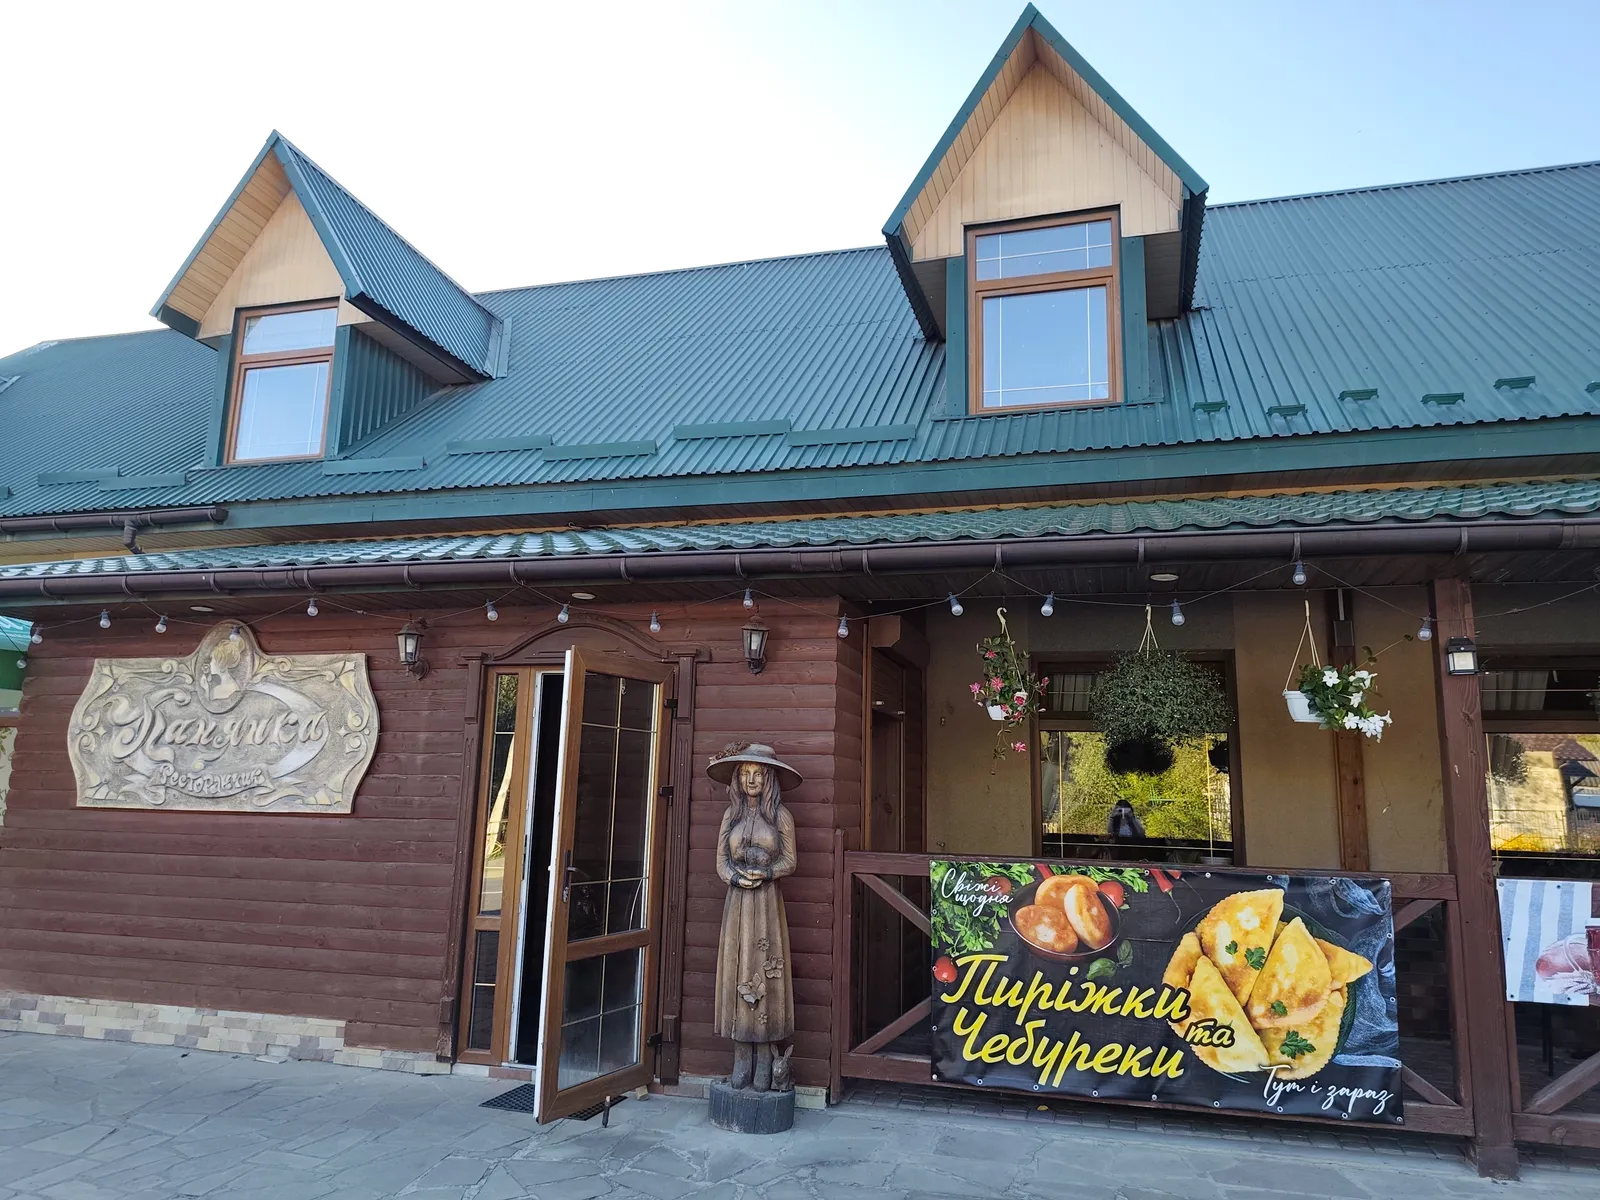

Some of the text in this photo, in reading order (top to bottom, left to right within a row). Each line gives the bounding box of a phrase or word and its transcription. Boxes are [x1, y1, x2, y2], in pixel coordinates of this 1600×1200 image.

[103, 688, 328, 763] Панянка
[941, 868, 1001, 898] Свіжі
[955, 893, 1013, 917] щодня
[941, 954, 1188, 1026] Пиріжки
[952, 1006, 1184, 1088] Чебуреки
[1186, 1021, 1233, 1046] та
[1260, 1064, 1394, 1115] Тут і зараз
